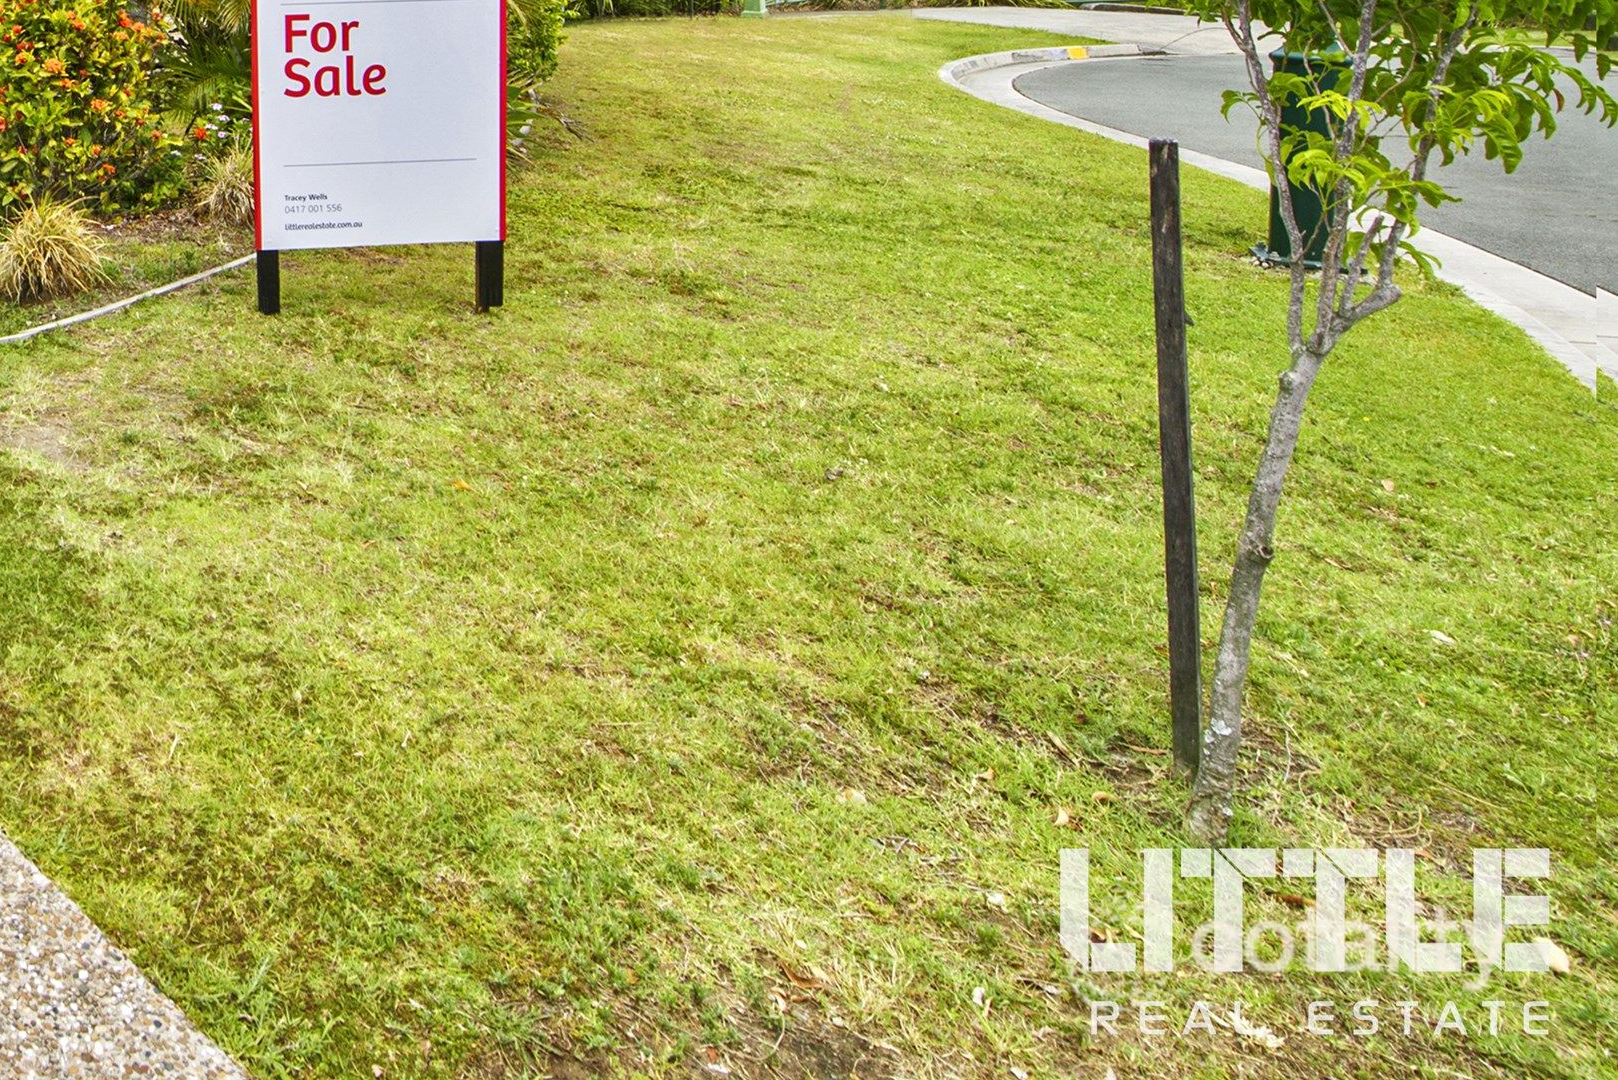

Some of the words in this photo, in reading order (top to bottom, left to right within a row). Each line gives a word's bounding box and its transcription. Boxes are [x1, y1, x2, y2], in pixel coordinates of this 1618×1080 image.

[284, 14, 360, 53] For
[284, 55, 387, 98] Sale
[284, 194, 307, 202] Tracey
[308, 193, 328, 201] Wells
[284, 205, 305, 214] 0417
[308, 204, 324, 213] 001
[326, 203, 343, 212] 556
